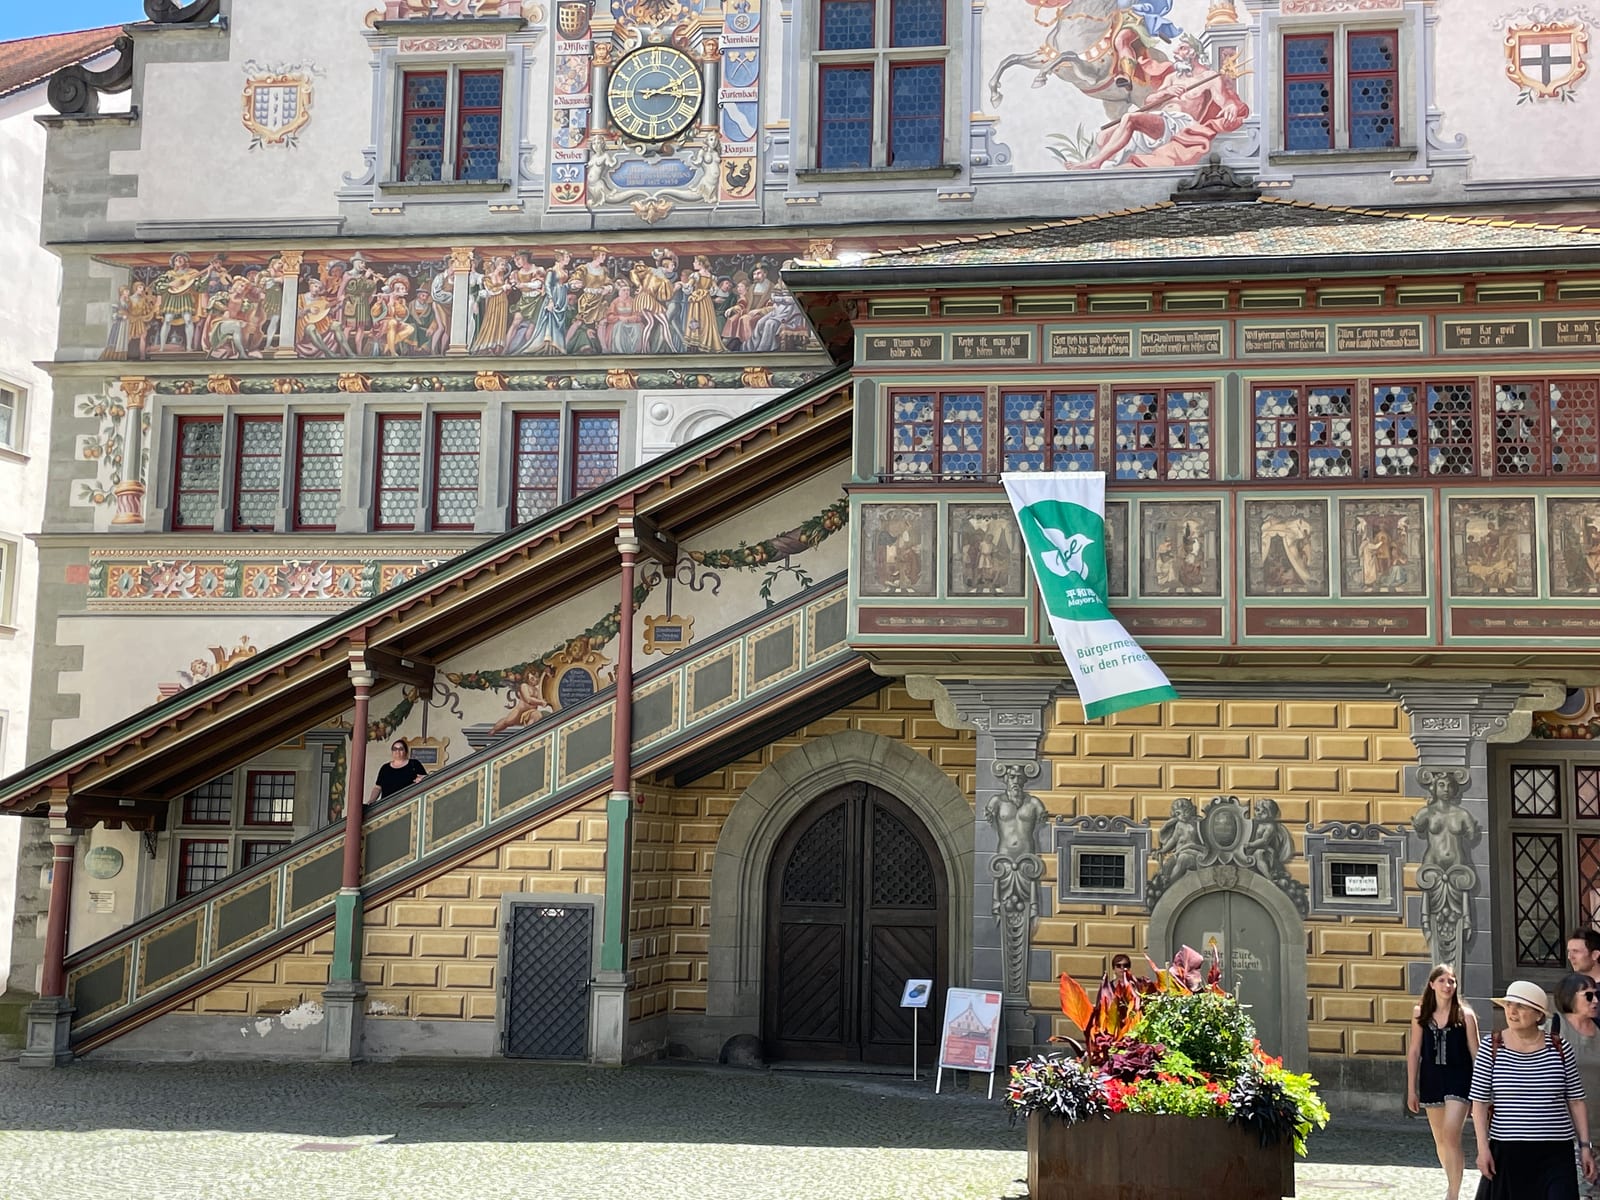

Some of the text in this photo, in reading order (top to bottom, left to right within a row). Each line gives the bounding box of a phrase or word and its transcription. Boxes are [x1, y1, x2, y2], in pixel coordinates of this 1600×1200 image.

[555, 151, 582, 161] Gruber
[1068, 596, 1096, 608] Mayors
[1079, 664, 1096, 676] für
[1098, 658, 1119, 670] den
